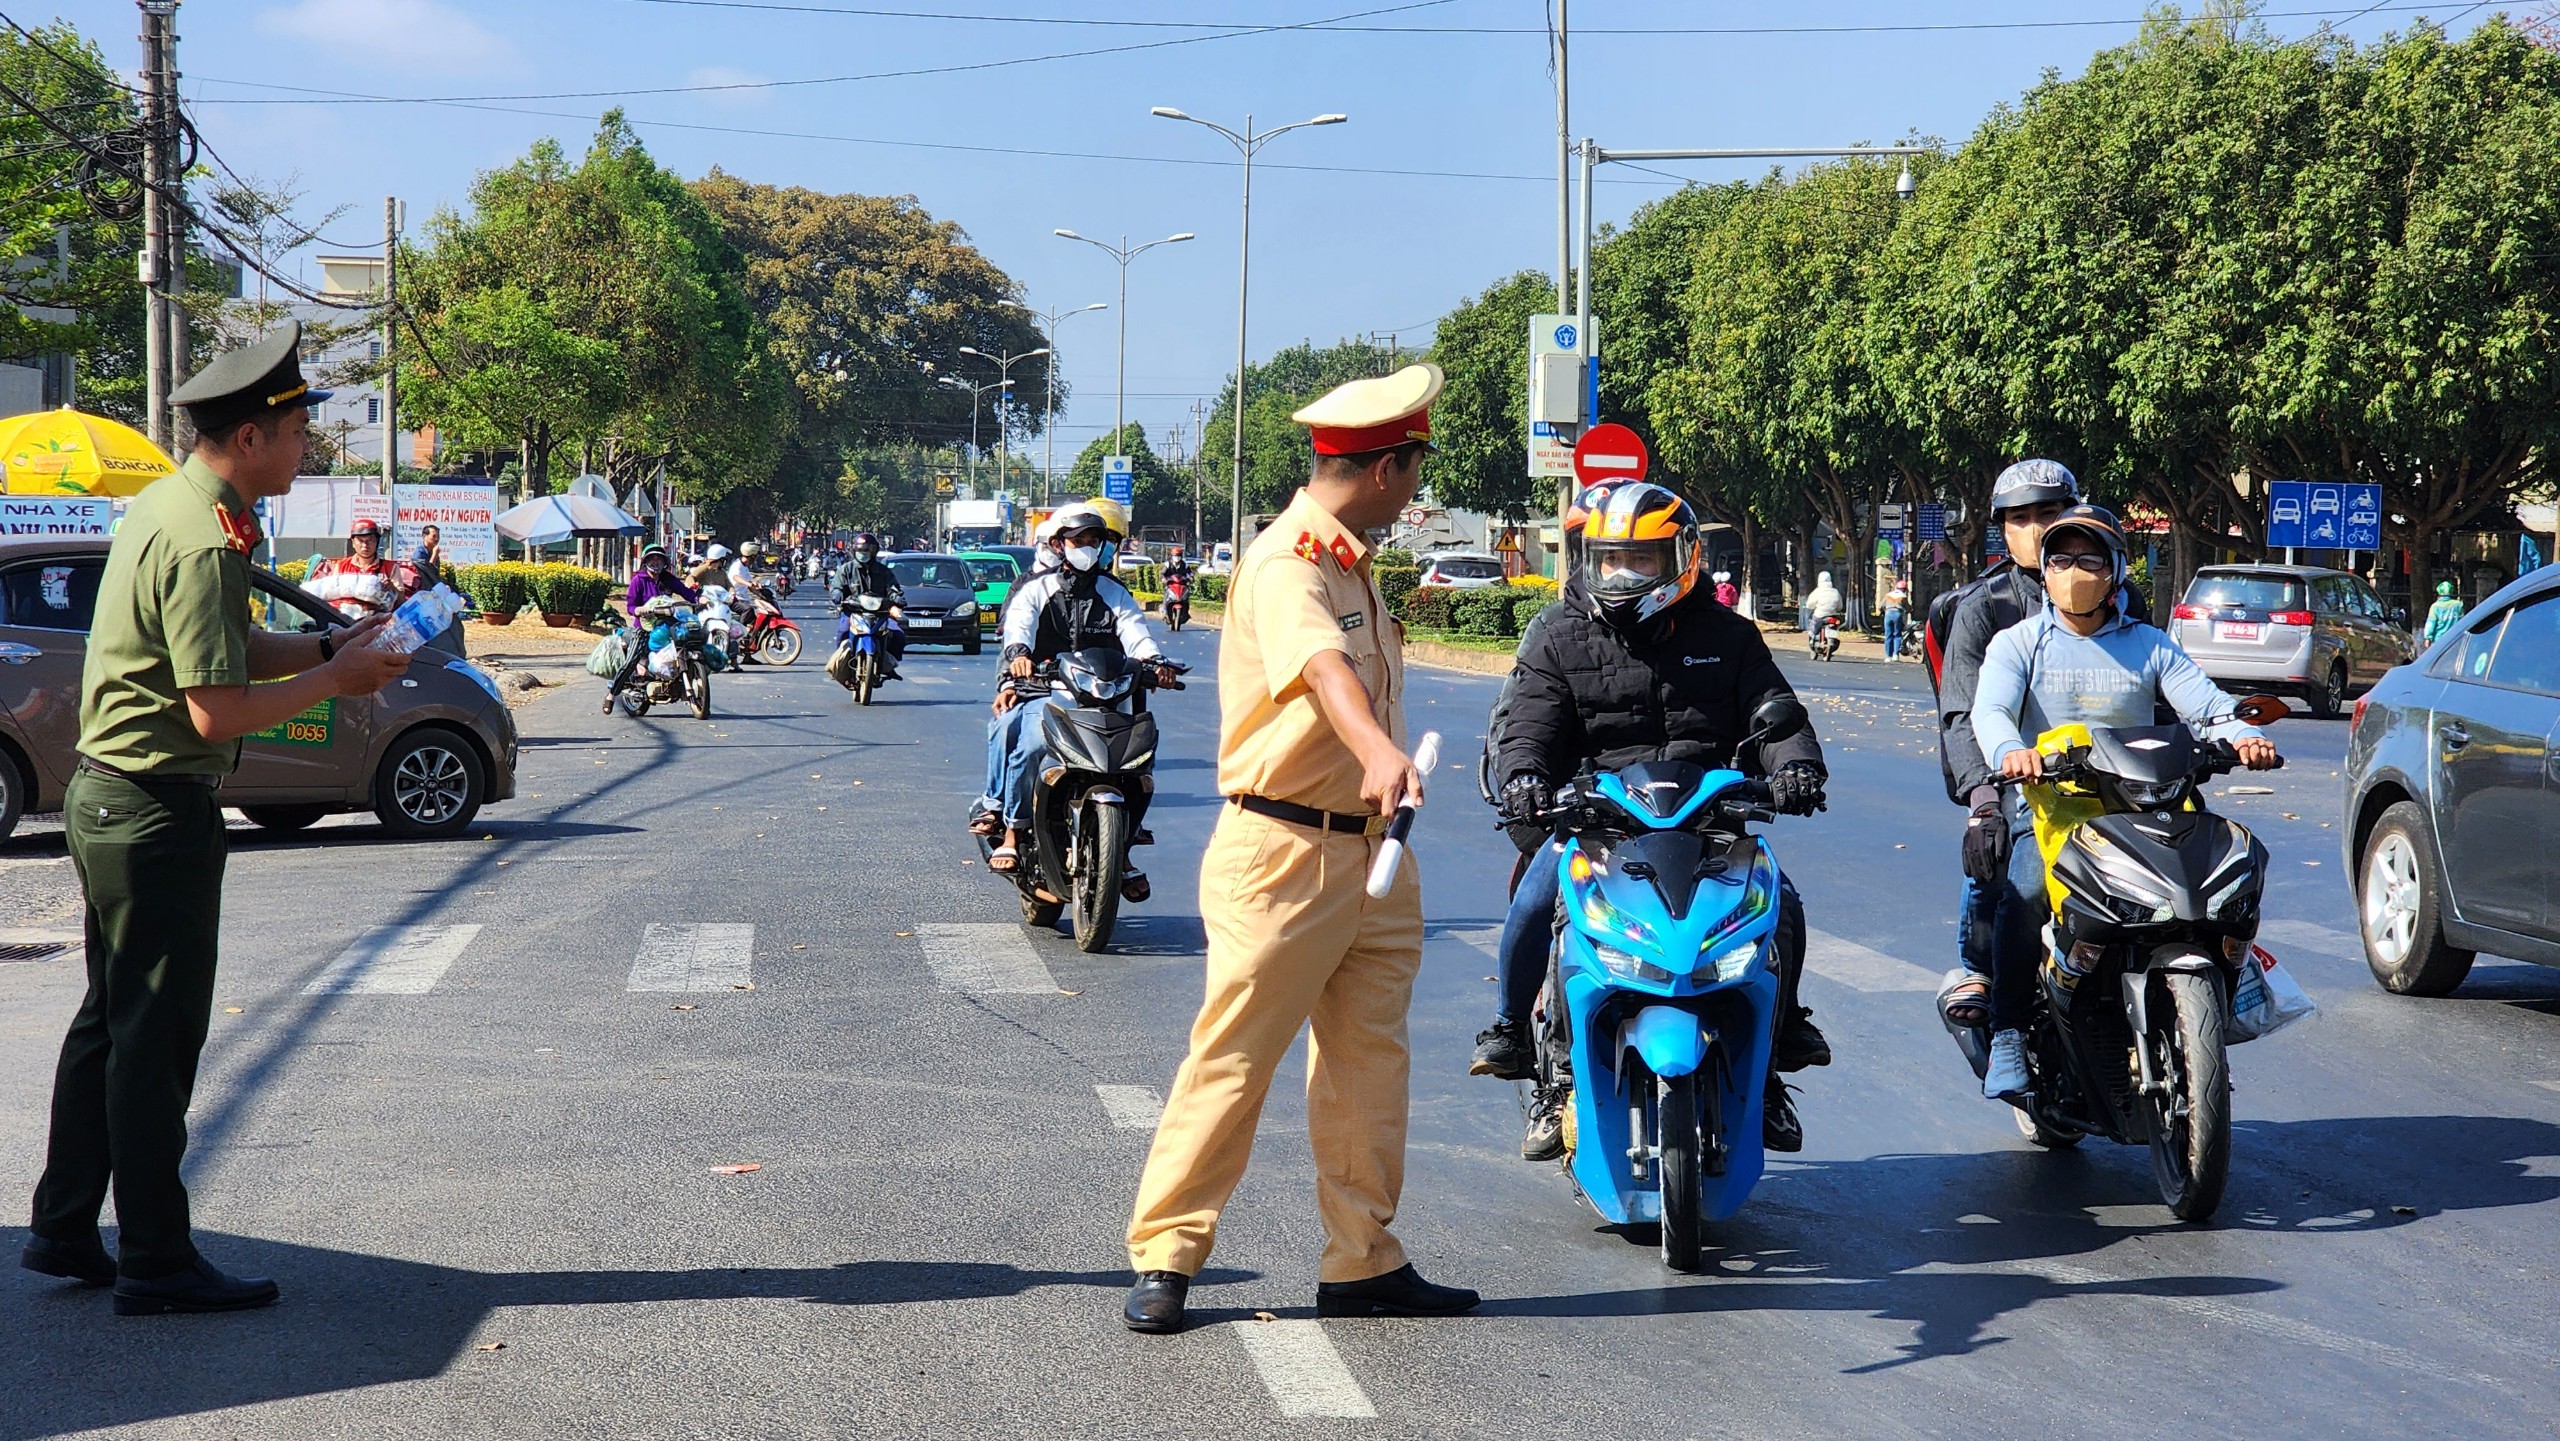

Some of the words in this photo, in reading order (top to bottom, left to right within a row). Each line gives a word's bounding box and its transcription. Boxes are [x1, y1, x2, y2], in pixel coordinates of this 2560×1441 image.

[463, 491, 473, 501] BS
[5, 503, 56, 516] NHÀ
[64, 505, 95, 517] XE
[397, 507, 412, 522] NHI
[440, 505, 456, 522] TÂY
[457, 506, 491, 524] NGUYÊN
[287, 722, 326, 742] 1055
